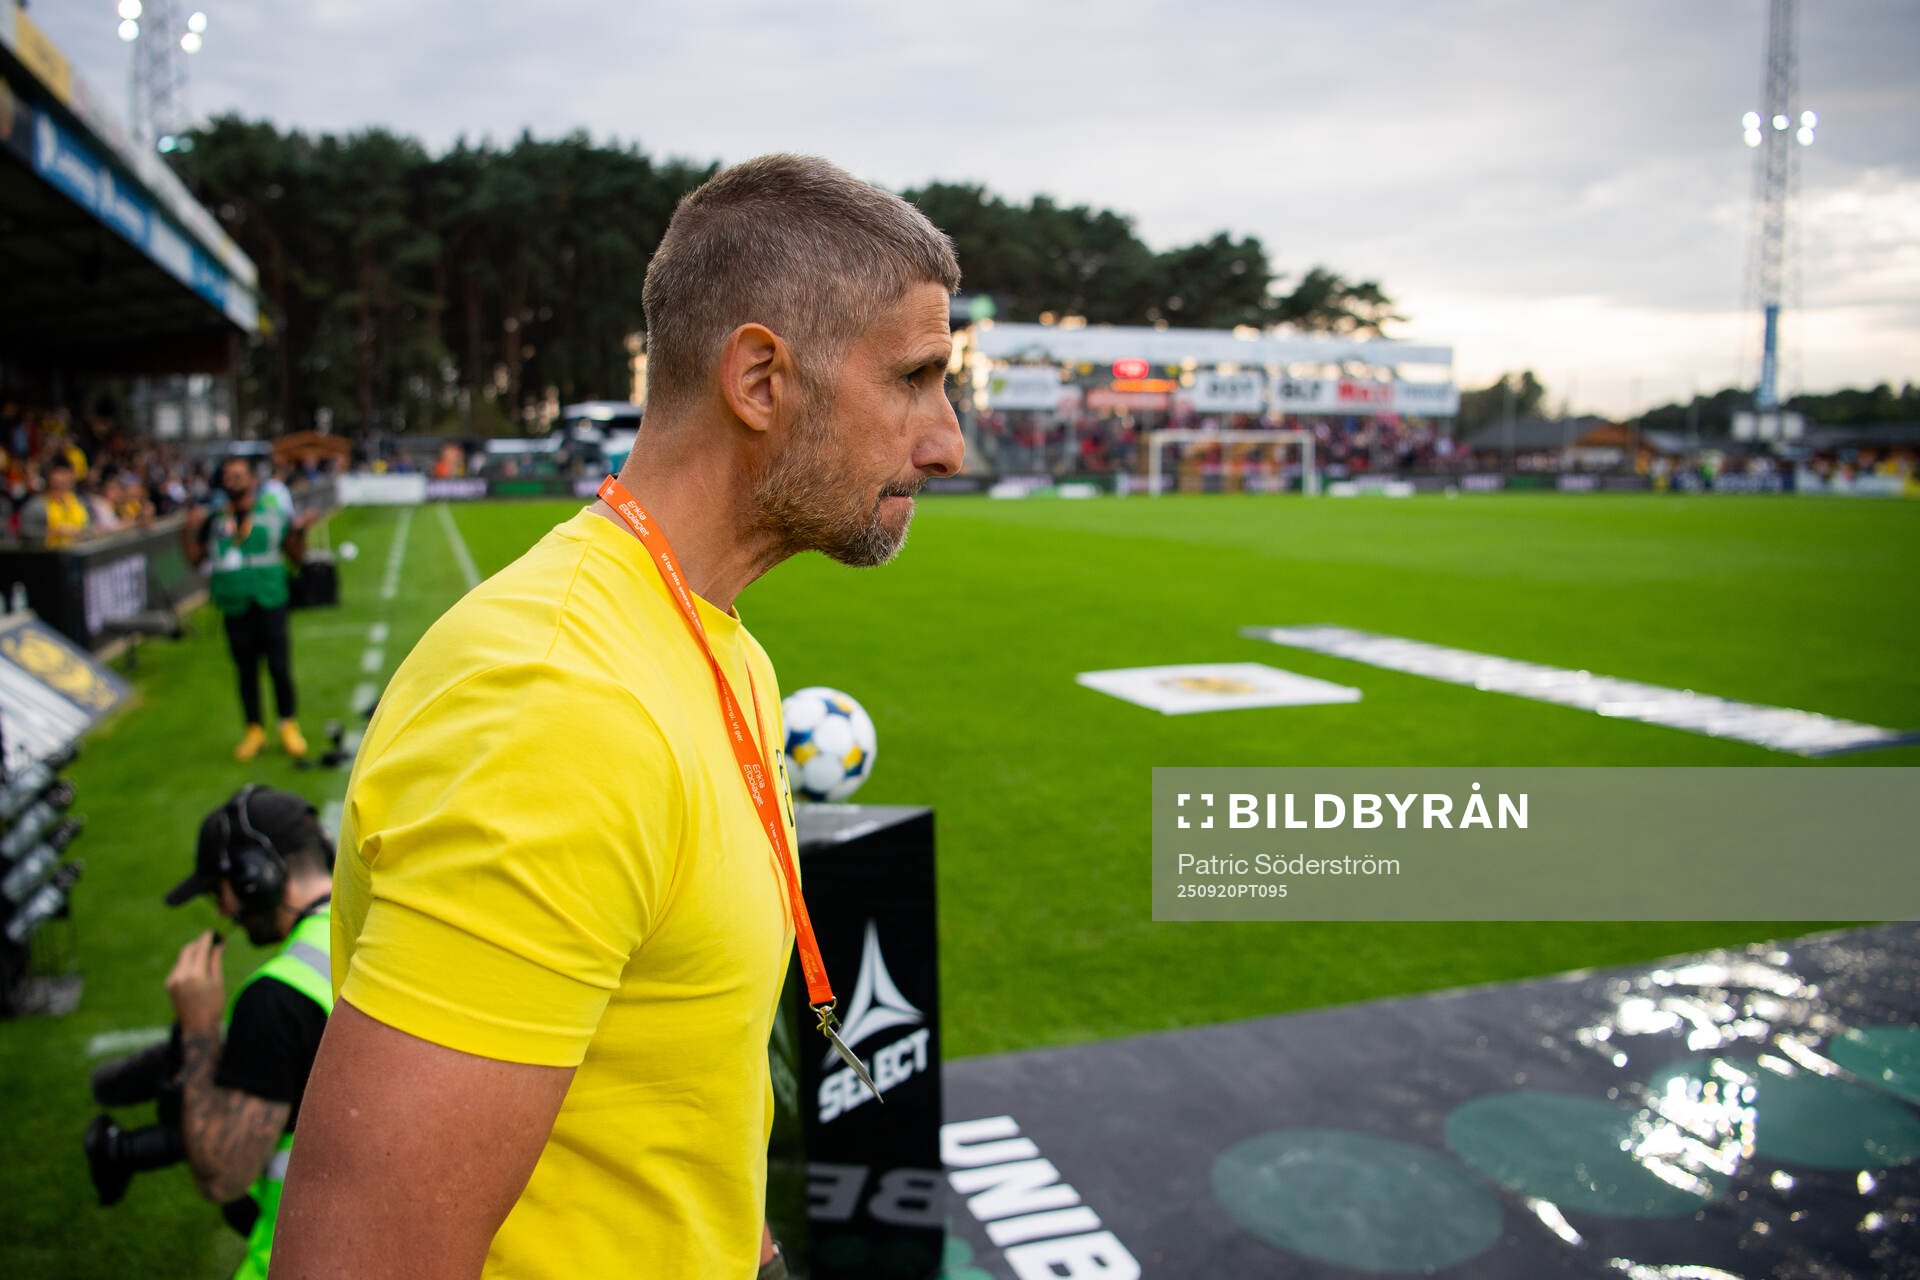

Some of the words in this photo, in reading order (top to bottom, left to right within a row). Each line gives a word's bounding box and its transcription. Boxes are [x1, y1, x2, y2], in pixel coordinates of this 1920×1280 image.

[618, 503, 650, 536] Elbolaget
[627, 500, 647, 521] Enkla
[743, 764, 764, 807] Elbolaget
[752, 763, 766, 789] Enkla
[818, 1027, 930, 1124] SELECT
